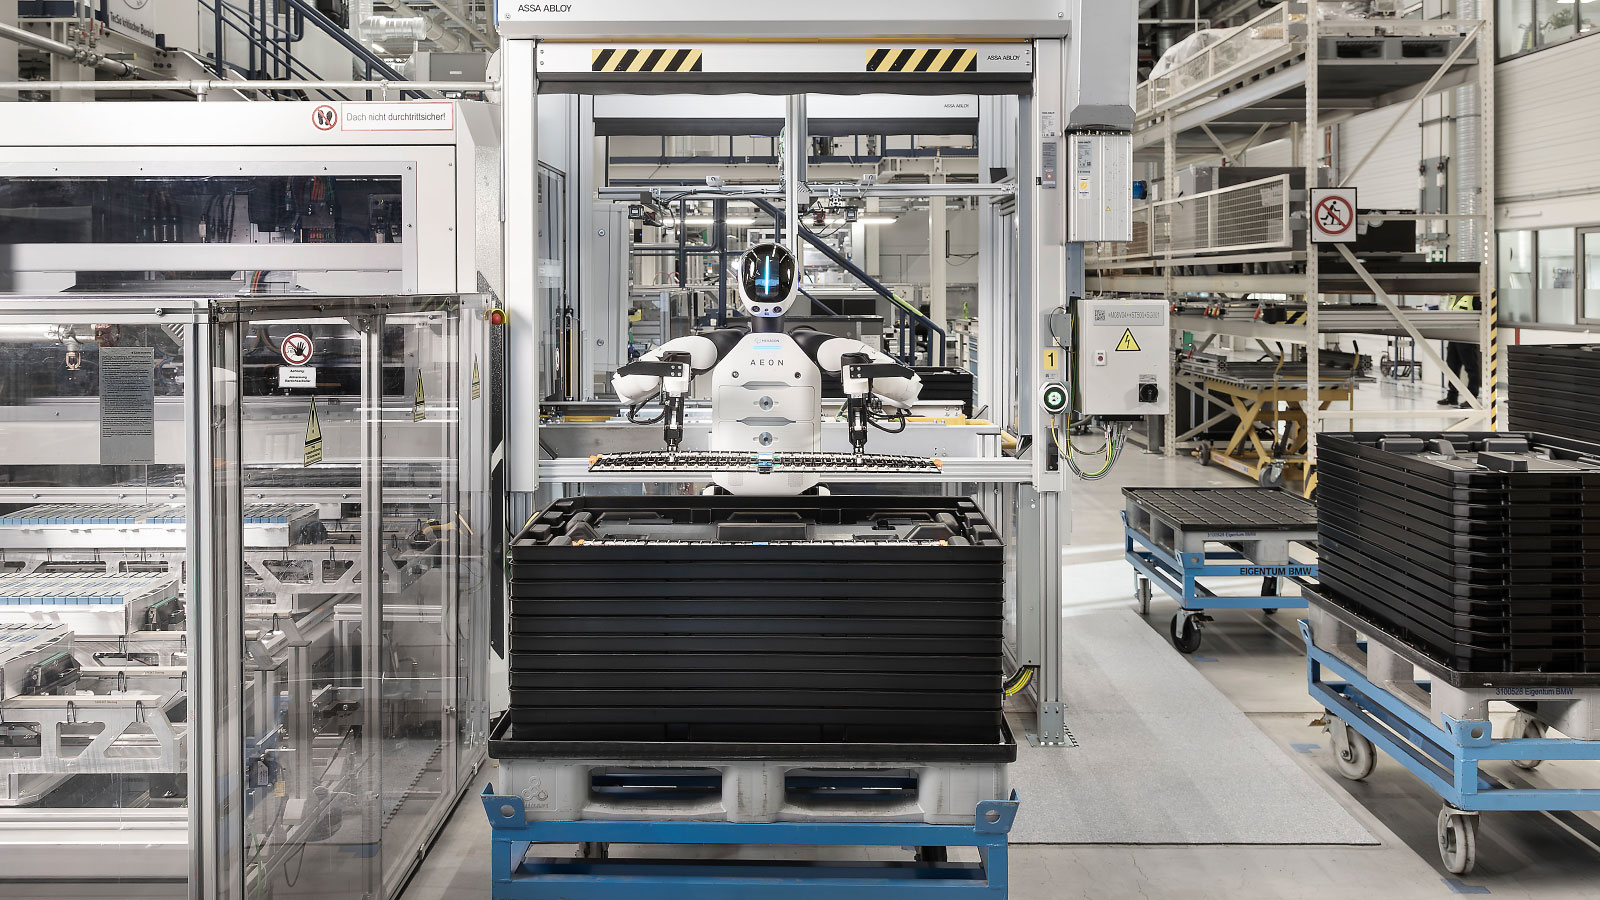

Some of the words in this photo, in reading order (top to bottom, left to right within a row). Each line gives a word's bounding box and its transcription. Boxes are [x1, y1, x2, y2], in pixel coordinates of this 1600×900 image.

[518, 4, 541, 13] ASSA
[543, 4, 572, 13] ABLOY
[122, 17, 140, 33] kritischer
[140, 23, 155, 39] Bereich
[346, 112, 367, 121] Dach
[368, 112, 387, 121] nicht
[388, 112, 446, 121] durchtrittsicher!
[1048, 352, 1054, 367] 1
[1240, 567, 1286, 576] EIGENTUM
[1289, 567, 1312, 576] BMW
[1496, 687, 1523, 696] 3100528
[1525, 687, 1555, 697] Eigentum
[1555, 687, 1574, 696] BMW
